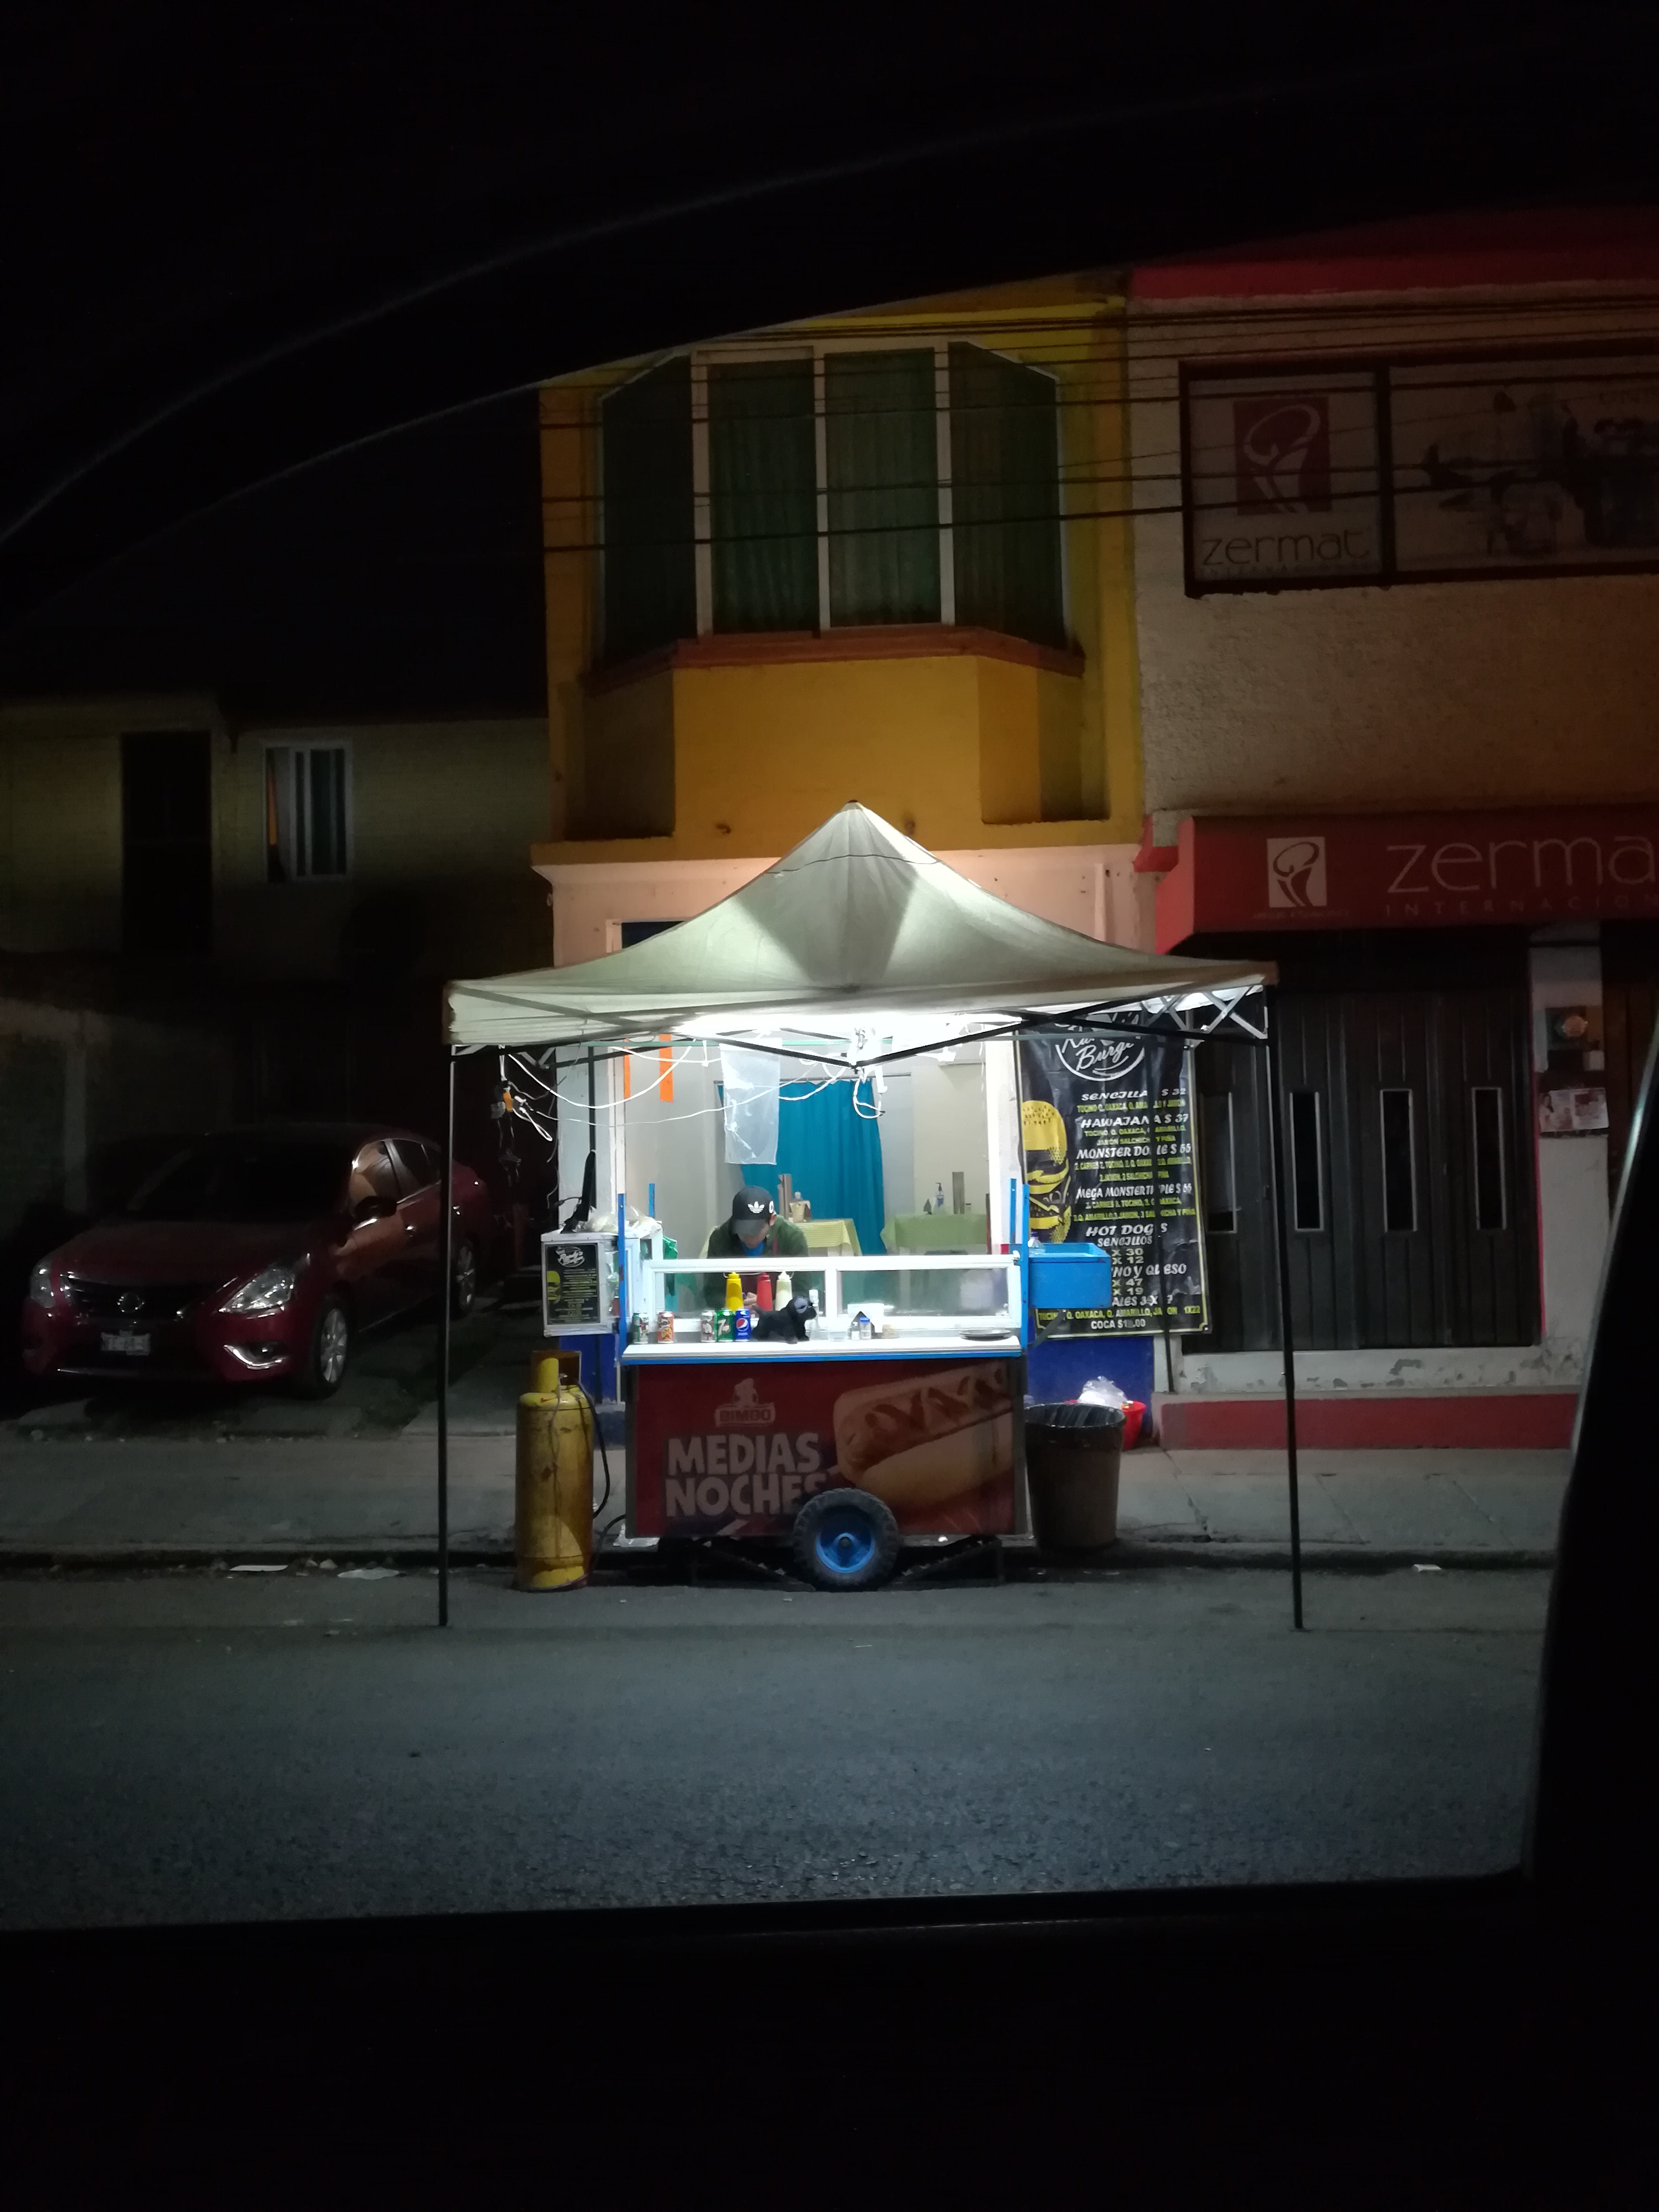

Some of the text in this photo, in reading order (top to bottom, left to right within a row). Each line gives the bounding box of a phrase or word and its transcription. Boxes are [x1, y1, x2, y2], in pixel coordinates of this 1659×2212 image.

[1202, 530, 1370, 566] zermat
[1386, 836, 1656, 893] zerma
[1172, 1088, 1186, 1096] 32
[1175, 1113, 1189, 1123] 37
[1076, 1146, 1132, 1160] MONSTER
[1133, 1143, 1168, 1157] DOLE
[1076, 1185, 1104, 1200] MEGA
[1105, 1185, 1146, 1198] MONSTER
[1085, 1226, 1117, 1236] HOT
[1097, 1235, 1153, 1247] SENCILLOS
[1090, 1320, 1115, 1330] COCA
[668, 1432, 821, 1476] MEDIAS
